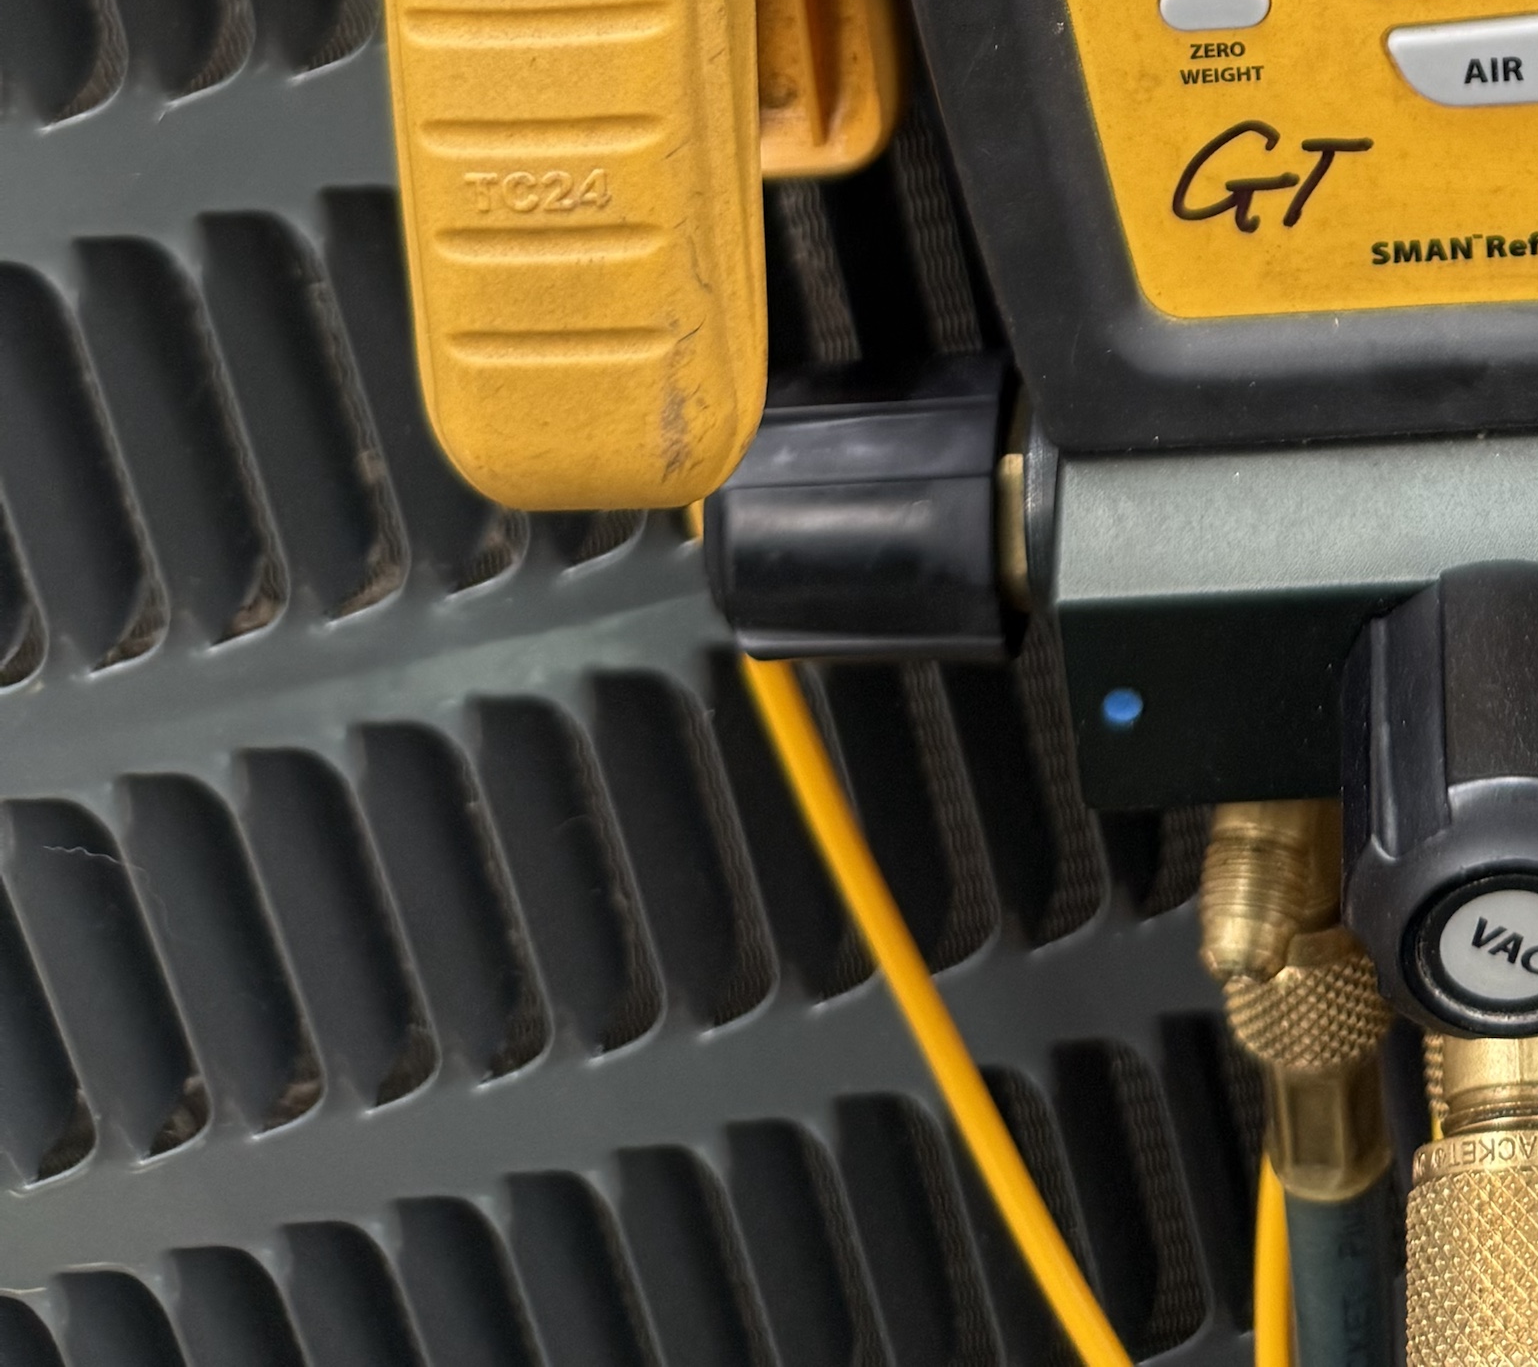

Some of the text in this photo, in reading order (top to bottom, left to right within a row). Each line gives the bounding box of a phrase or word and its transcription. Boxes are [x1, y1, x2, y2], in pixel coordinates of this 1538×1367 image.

[1189, 41, 1246, 60] ZERO
[1180, 65, 1265, 85] WEIGHT
[1463, 56, 1524, 85] AIR
[464, 168, 613, 213] TC24
[1171, 119, 1375, 233] GT
